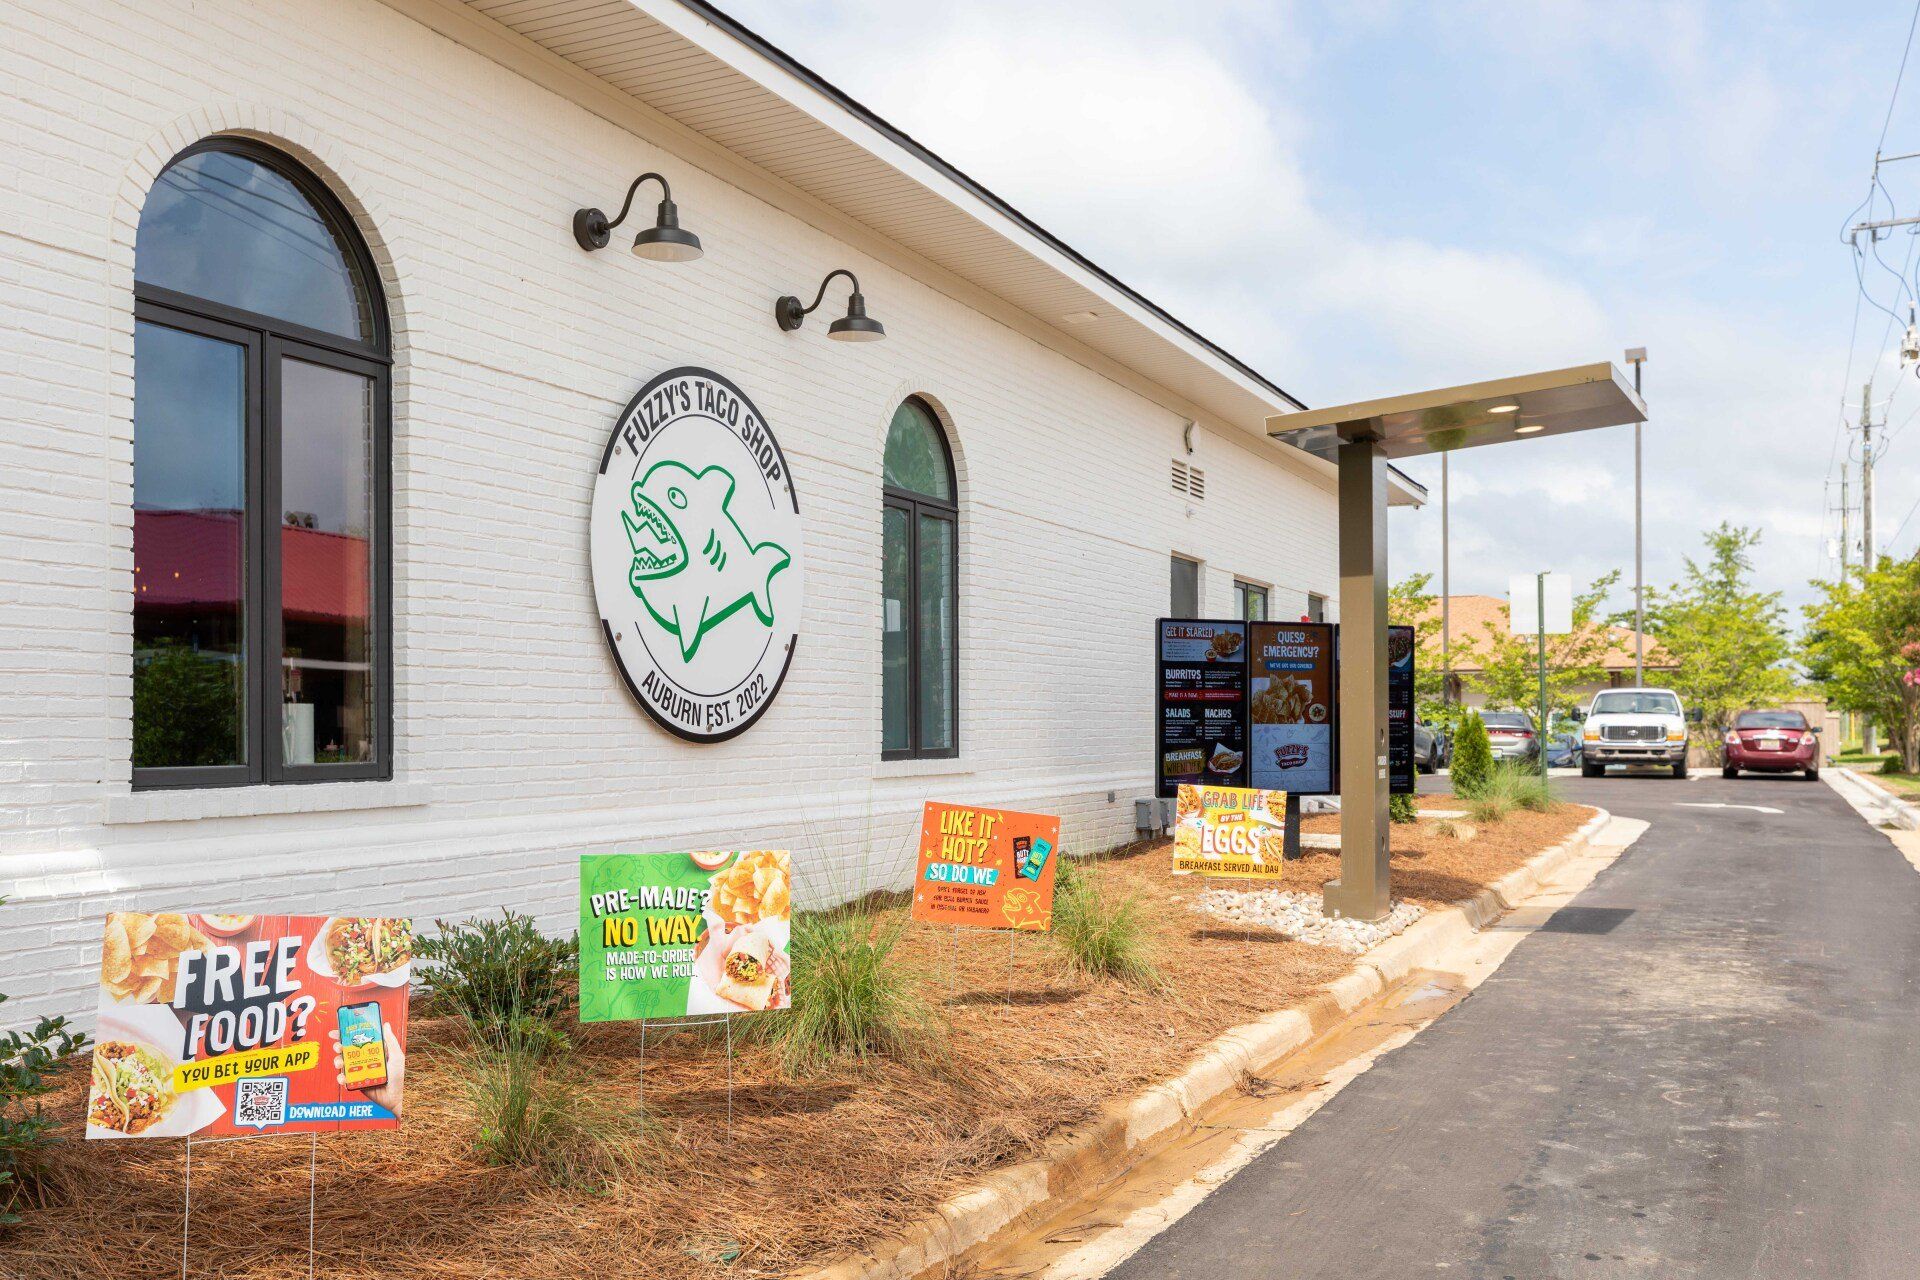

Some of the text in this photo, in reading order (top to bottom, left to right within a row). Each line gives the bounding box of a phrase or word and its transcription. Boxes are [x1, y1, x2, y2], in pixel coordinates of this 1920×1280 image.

[623, 380, 781, 483] FUZZY'S TACO SHOP
[1178, 627, 1185, 637] IT
[1277, 631, 1306, 645] QUESO
[1263, 645, 1319, 658] EMERGENCY?
[1165, 669, 1202, 680] BURRITOS
[641, 669, 768, 728] AUBURN EST. 2022
[1165, 708, 1191, 718] SALADS
[1204, 708, 1232, 718] NACHOS
[1165, 750, 1203, 762] BREAKFAST
[1202, 791, 1264, 811] GRAB LIFE
[940, 810, 996, 839] LIKE IT
[1201, 824, 1260, 855] EGGS
[941, 836, 989, 864] HOT?
[929, 863, 948, 881] SO
[951, 865, 969, 883] DO
[1179, 860, 1279, 874] BREAKFAST SERVED ALL DAY
[590, 886, 711, 917] PRE-MADE?
[603, 917, 638, 948] NO
[606, 949, 695, 966] MADE-TO-ORDER
[173, 936, 303, 1009] FREE
[606, 967, 616, 981] IS
[620, 965, 647, 980] HOW
[650, 965, 669, 978] WE
[188, 995, 316, 1056] FOOD?
[182, 1051, 310, 1083] YOU BET YOUR APP
[289, 1104, 374, 1119] DOWNLOAD HERE
